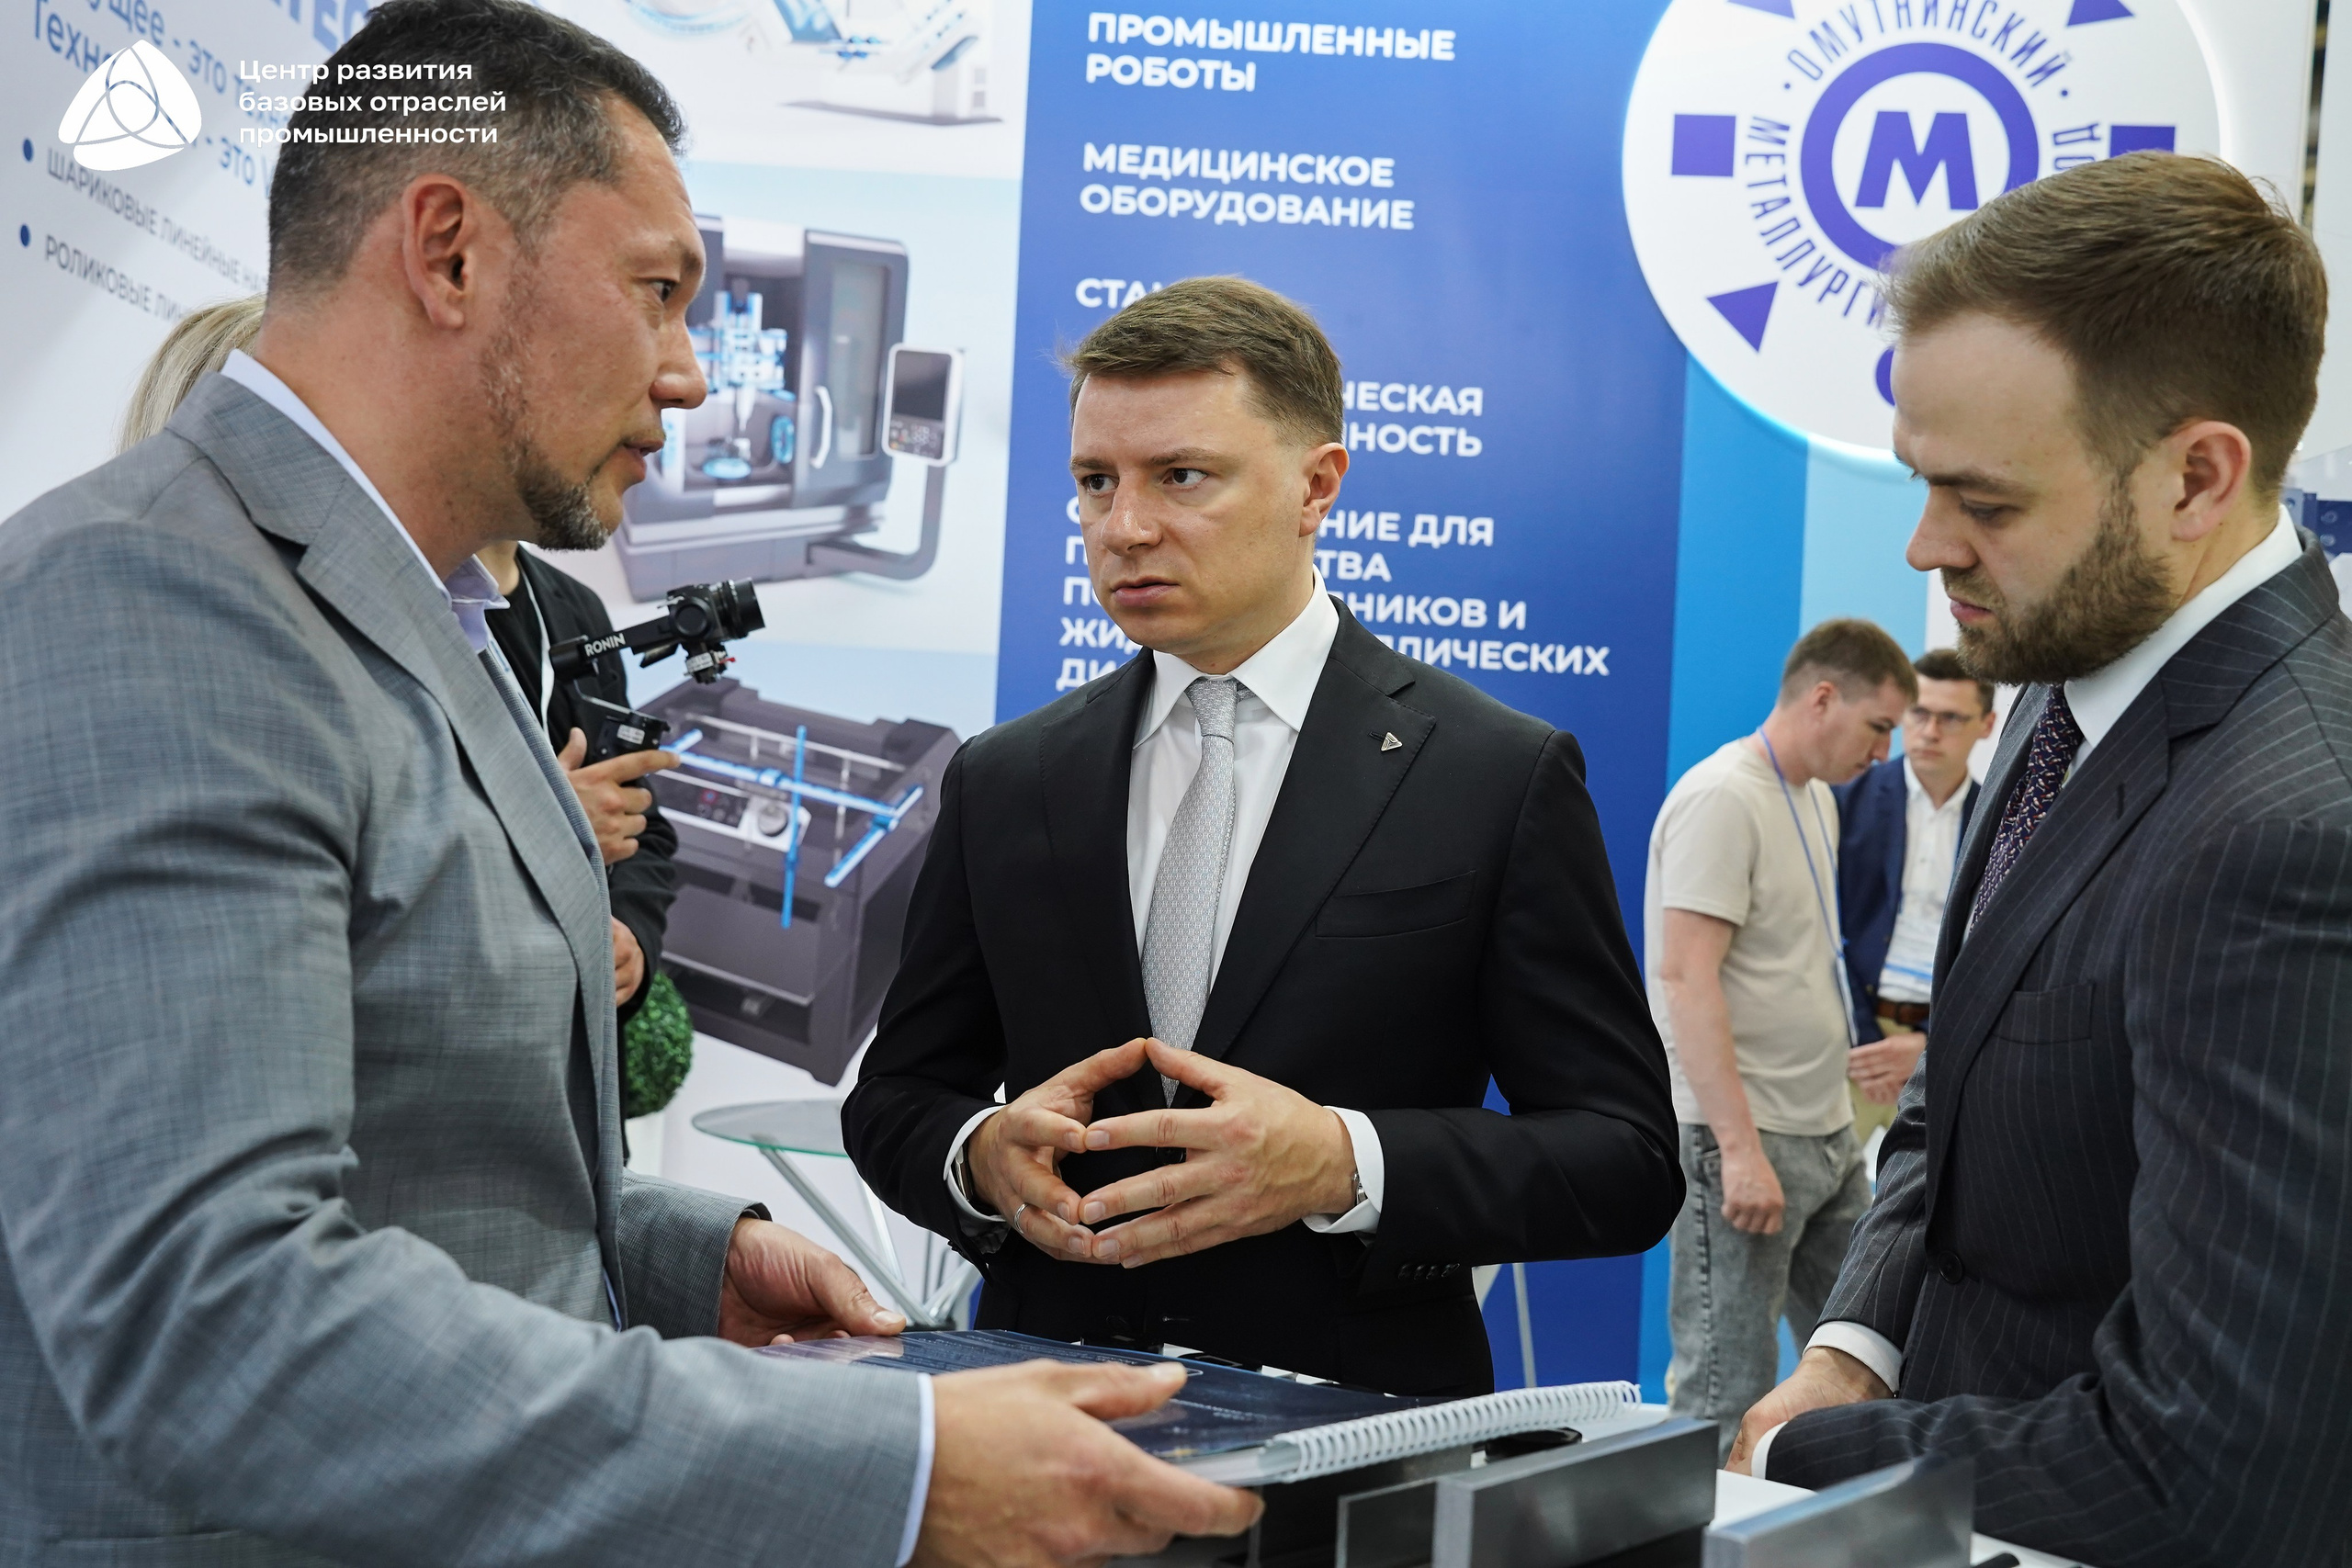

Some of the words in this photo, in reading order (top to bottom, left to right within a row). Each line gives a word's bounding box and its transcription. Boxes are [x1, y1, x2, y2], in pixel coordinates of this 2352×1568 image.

[1087, 11, 1458, 62] ПРОМЫШЛЕННЫЕ
[1085, 52, 1257, 93] РОБОТЫ
[1081, 141, 1396, 189] МЕДИЦИНСКОЕ
[1079, 183, 1416, 231] ОБОРУДОВАНИЕ
[45, 233, 151, 314] РОЛИКОВЫЕ
[1408, 513, 1496, 548] ДЛЯ
[1498, 600, 1527, 631] И
[584, 633, 627, 657] RONIN
